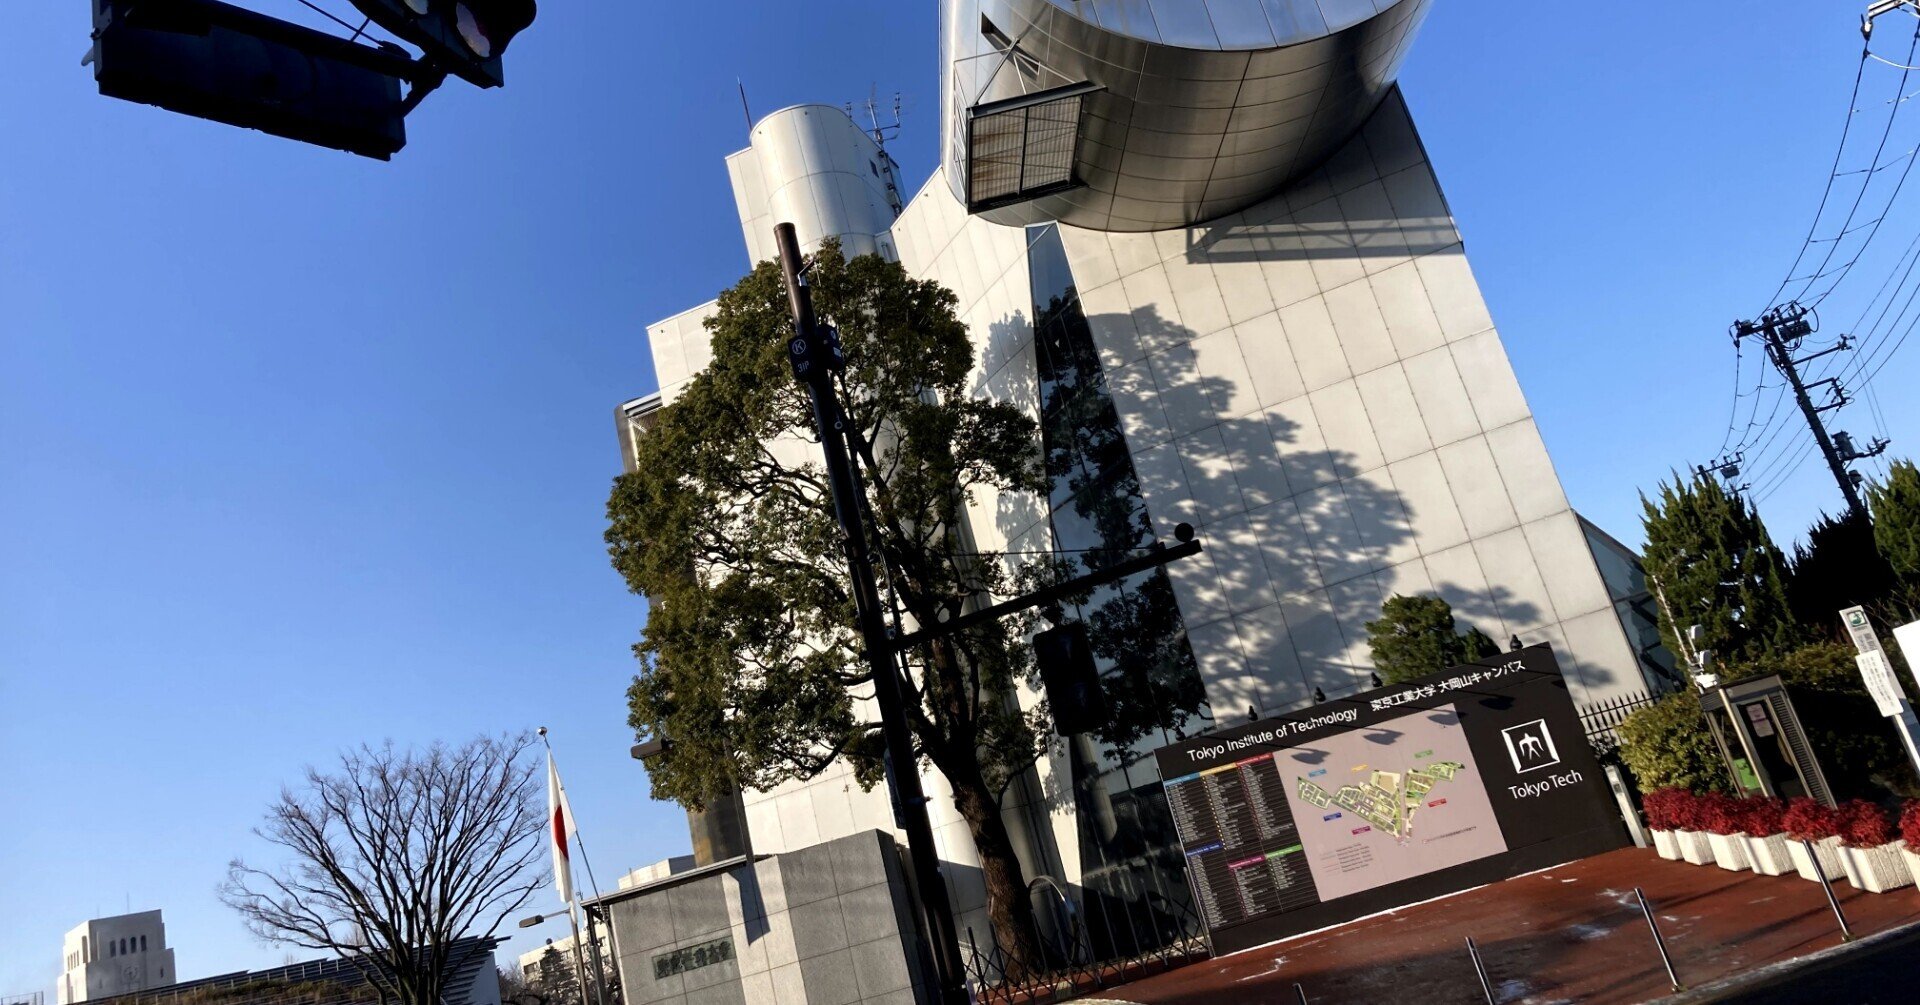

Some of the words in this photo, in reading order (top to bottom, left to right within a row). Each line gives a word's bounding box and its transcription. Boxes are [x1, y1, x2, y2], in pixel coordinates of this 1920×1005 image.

[1369, 685, 1437, 712] 東京工業大学
[1438, 660, 1526, 693] 大岡山キャンパス
[1187, 745, 1225, 762] Tokyo
[1227, 731, 1274, 752] Institute
[1275, 725, 1288, 739] of
[1288, 708, 1358, 734] Technology
[1508, 781, 1550, 799] Tokyo
[1548, 769, 1583, 788] Tech
